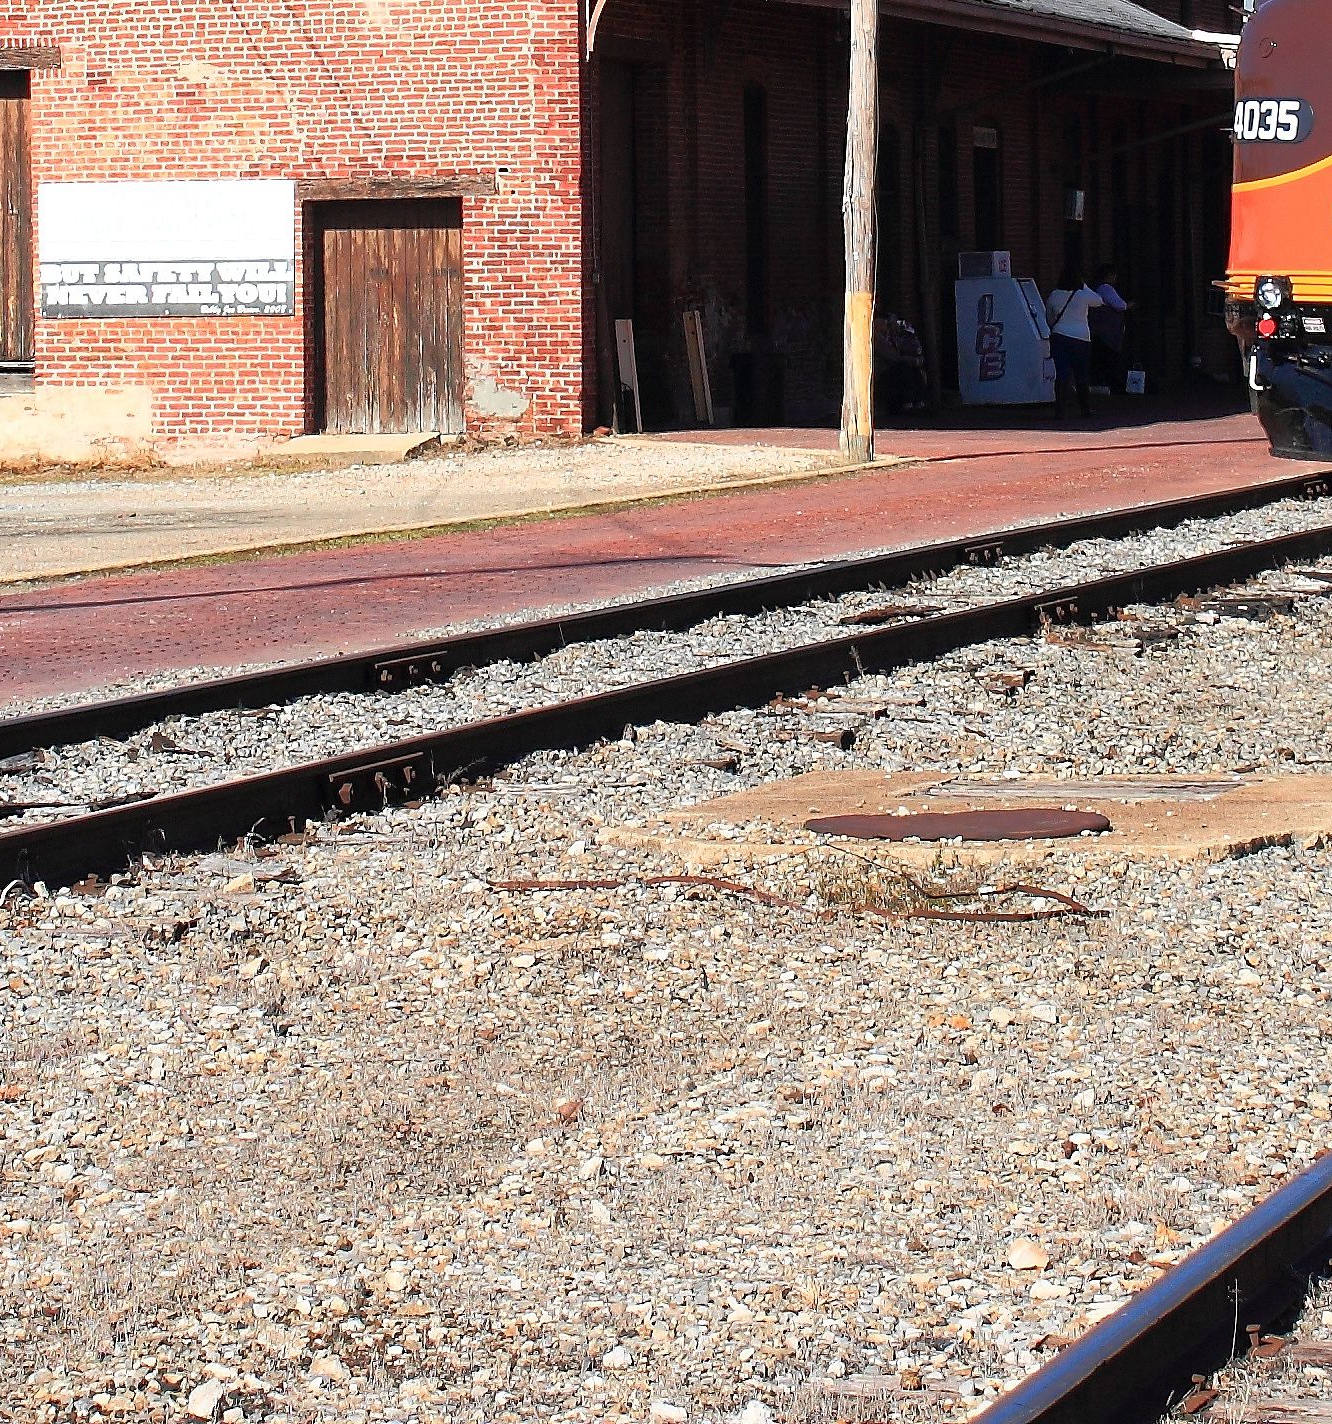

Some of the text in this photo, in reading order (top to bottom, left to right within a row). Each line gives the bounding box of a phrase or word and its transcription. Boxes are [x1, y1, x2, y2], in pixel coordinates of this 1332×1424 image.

[1234, 100, 1300, 141] 4035
[40, 263, 99, 284] BUT
[104, 263, 215, 283] SAFETY
[46, 284, 149, 305] NEVER
[151, 283, 219, 304] FAIL
[976, 294, 1006, 382] ICE
